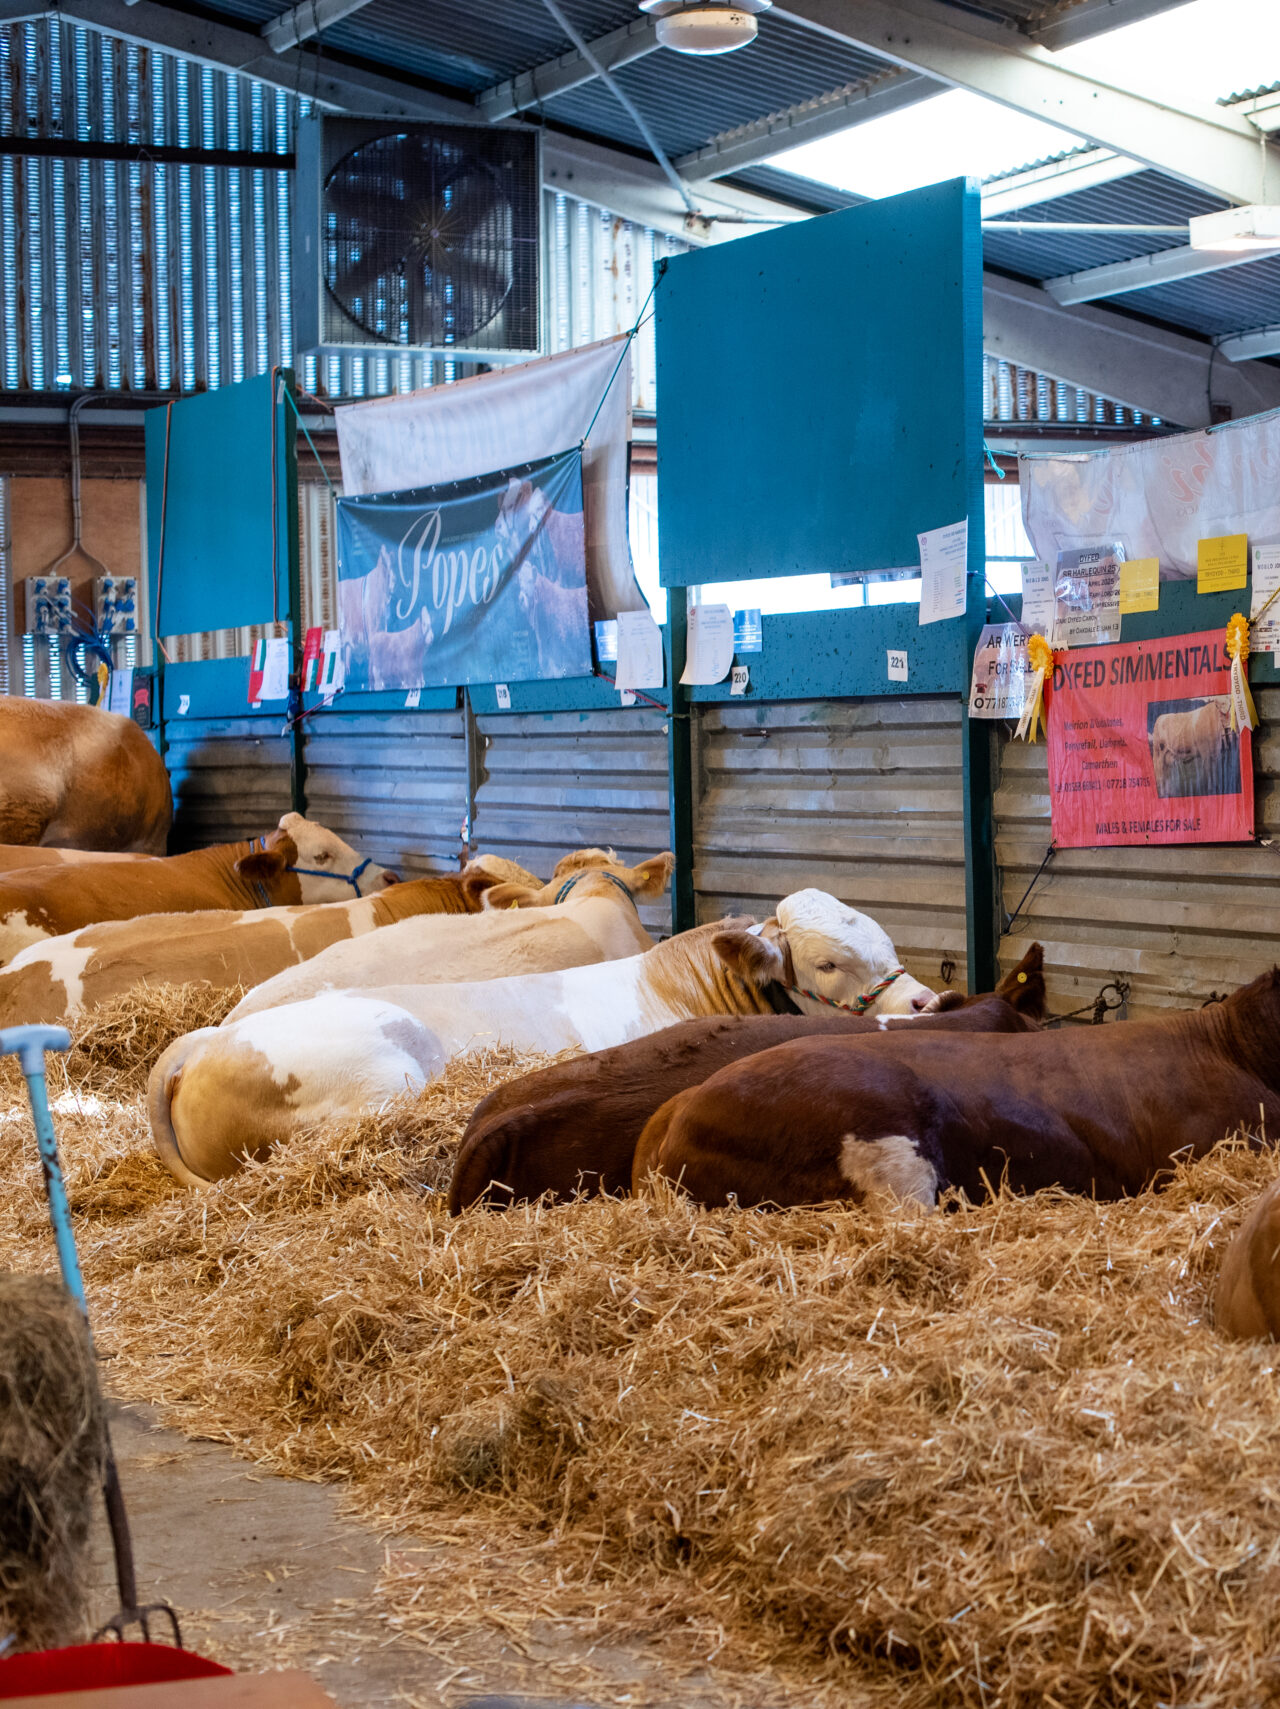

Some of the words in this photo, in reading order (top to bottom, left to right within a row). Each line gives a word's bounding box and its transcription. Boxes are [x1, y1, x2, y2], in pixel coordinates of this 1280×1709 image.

[1080, 553, 1099, 563] DYFED
[397, 505, 503, 635] Popes
[1073, 567, 1107, 576] HARLEQUIN
[1108, 565, 1116, 573] 25
[986, 634, 1002, 648] AR
[989, 661, 1007, 675] FOR
[1010, 659, 1034, 673] SLE
[1053, 660, 1106, 692] DYFED
[1110, 644, 1232, 686] SIMMENTALS
[734, 672, 746, 683] 220
[1237, 700, 1246, 720] THIRD
[1096, 822, 1120, 835] MALES
[1129, 820, 1164, 833] FEMALES
[1166, 819, 1181, 832] FOR
[1183, 818, 1201, 831] SALE
